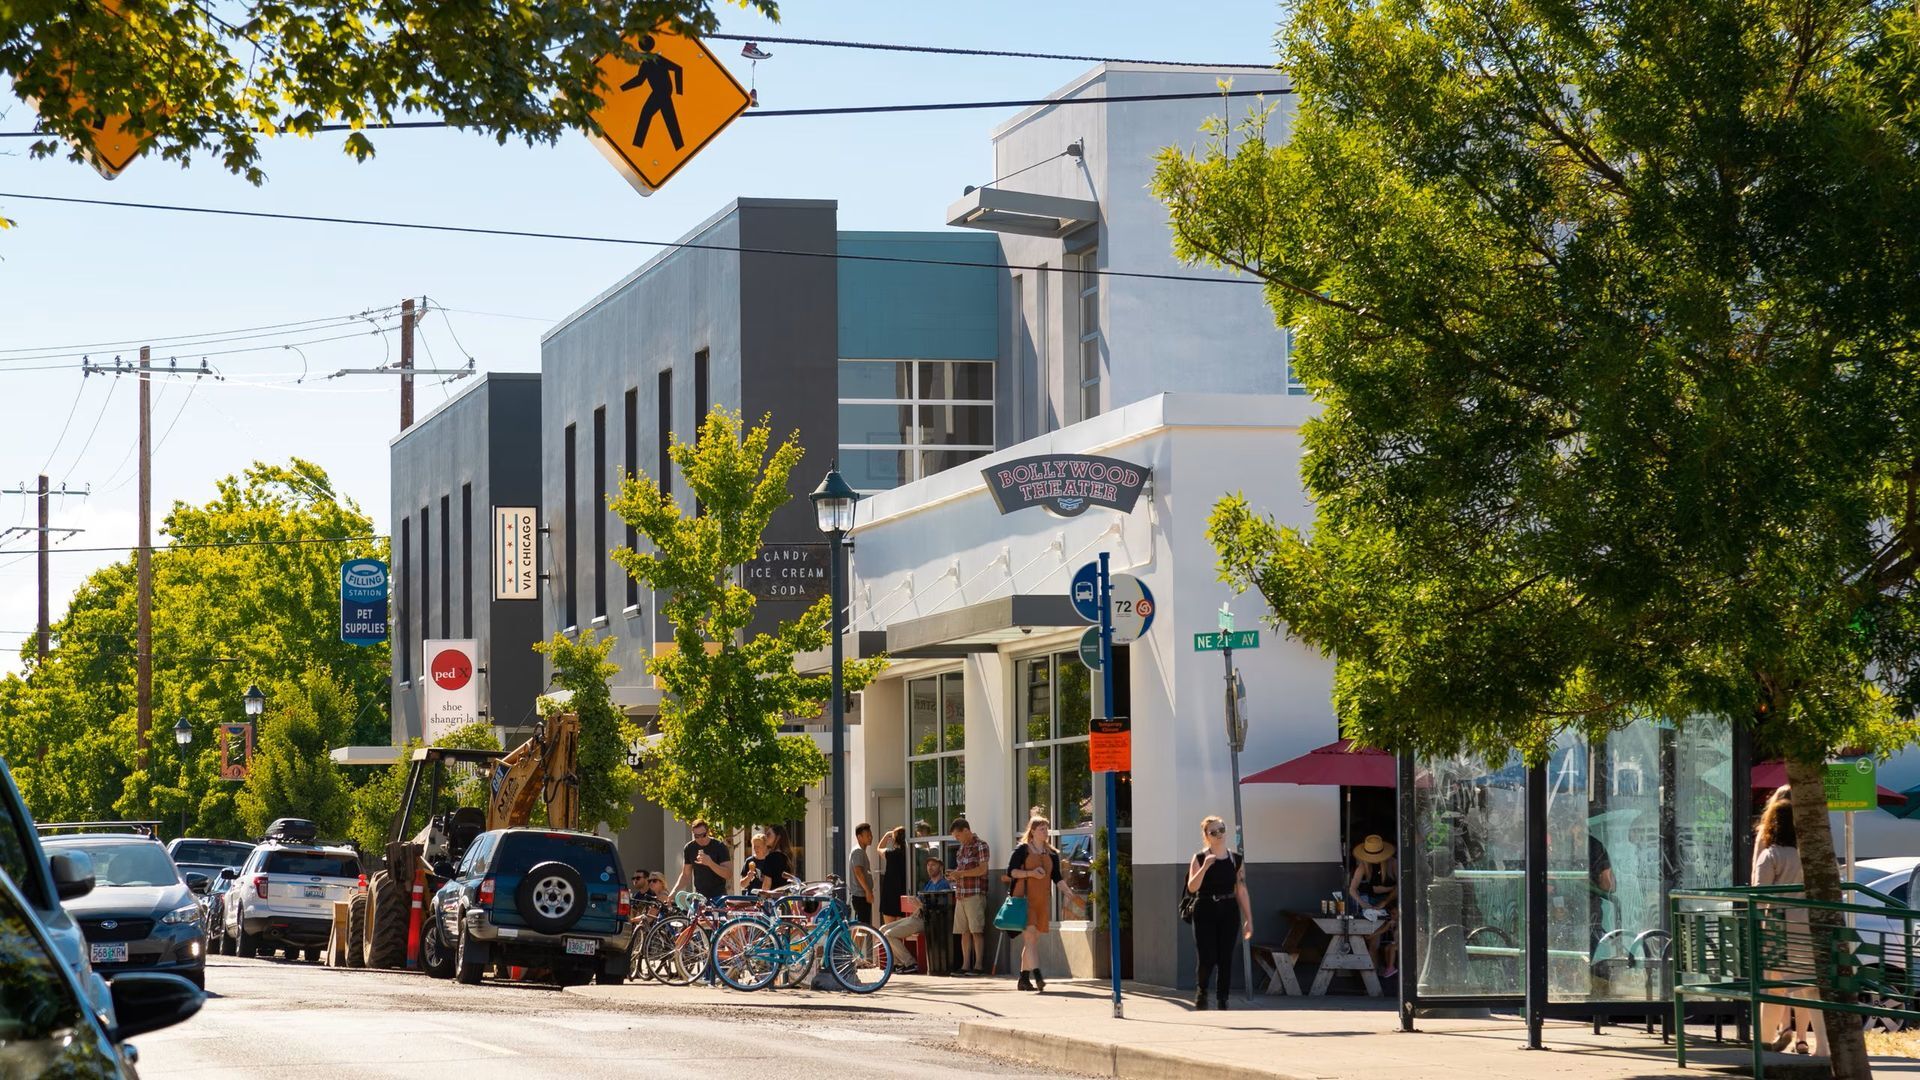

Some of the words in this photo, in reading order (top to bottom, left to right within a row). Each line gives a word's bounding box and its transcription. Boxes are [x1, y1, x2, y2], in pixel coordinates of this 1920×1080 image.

[998, 461, 1140, 488] BOLLYWOOD
[1019, 480, 1118, 501] THEATER
[522, 516, 531, 566] CHICAGO
[763, 550, 808, 562] CANDY
[751, 568, 771, 578] ICE
[781, 568, 824, 578] CREAM
[348, 575, 382, 586] FILLING
[523, 571, 531, 590] VIA
[348, 589, 382, 597] STATION
[770, 585, 806, 595] SODA
[1115, 600, 1132, 613] 72
[357, 608, 373, 620] PET
[345, 622, 385, 634] SUPPLIES
[1197, 635, 1212, 649] NE
[1241, 633, 1255, 646] AV
[435, 667, 456, 682] ped
[442, 701, 463, 711] shoe
